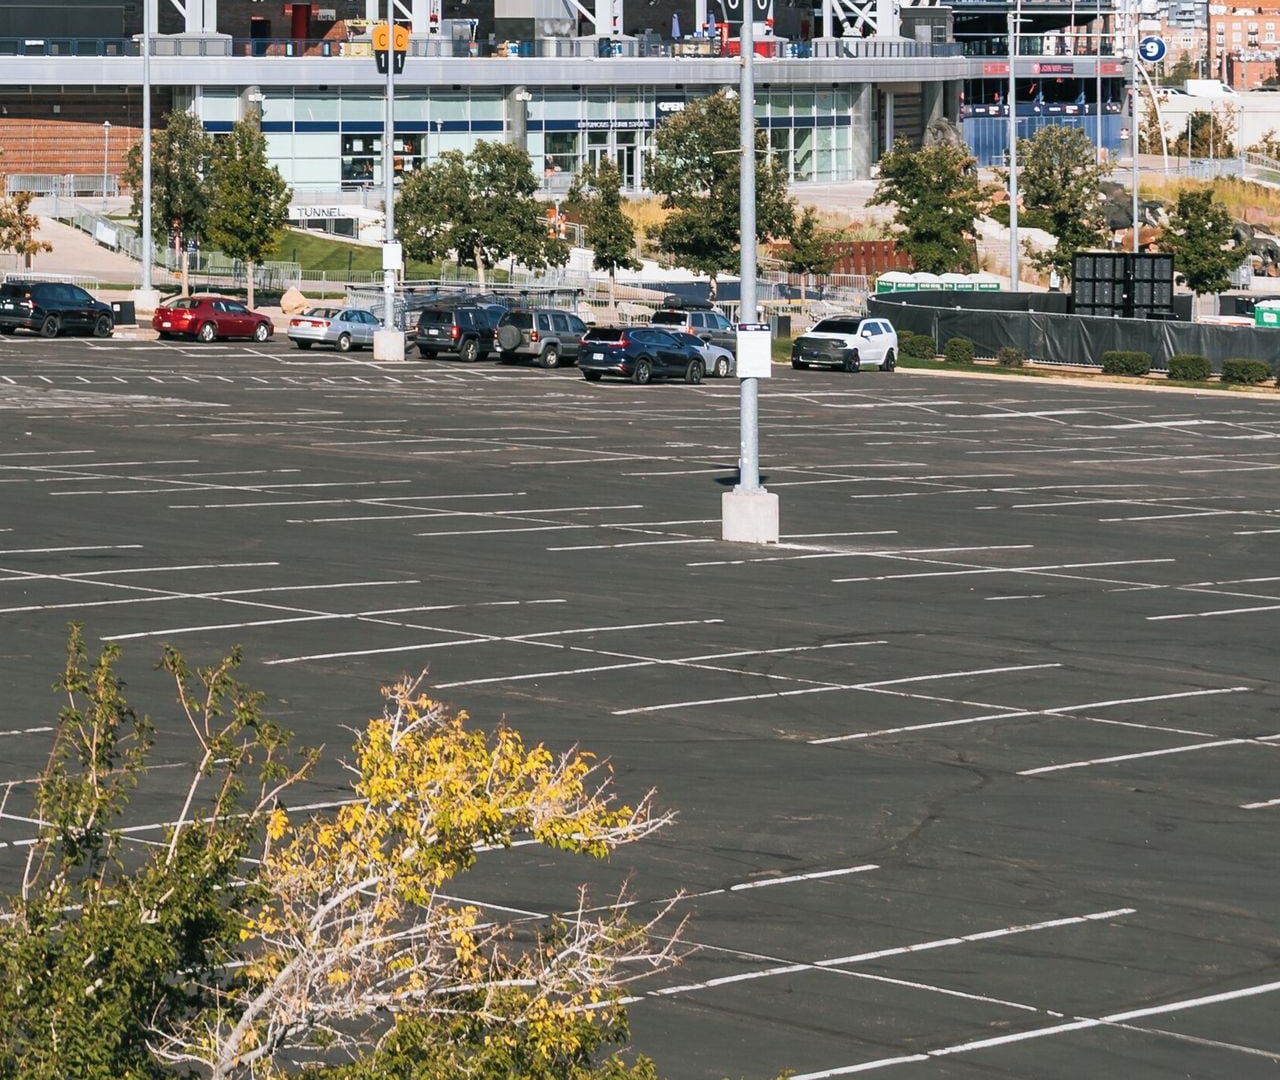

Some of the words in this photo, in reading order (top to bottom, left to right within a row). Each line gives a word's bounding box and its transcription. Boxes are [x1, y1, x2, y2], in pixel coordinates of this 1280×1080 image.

[379, 33, 386, 47] C
[396, 34, 403, 47] C
[1146, 42, 1159, 56] 9
[380, 54, 385, 67] 1
[397, 54, 402, 68] 1
[657, 102, 685, 111] OPEN
[297, 207, 345, 217] TUNNEL
